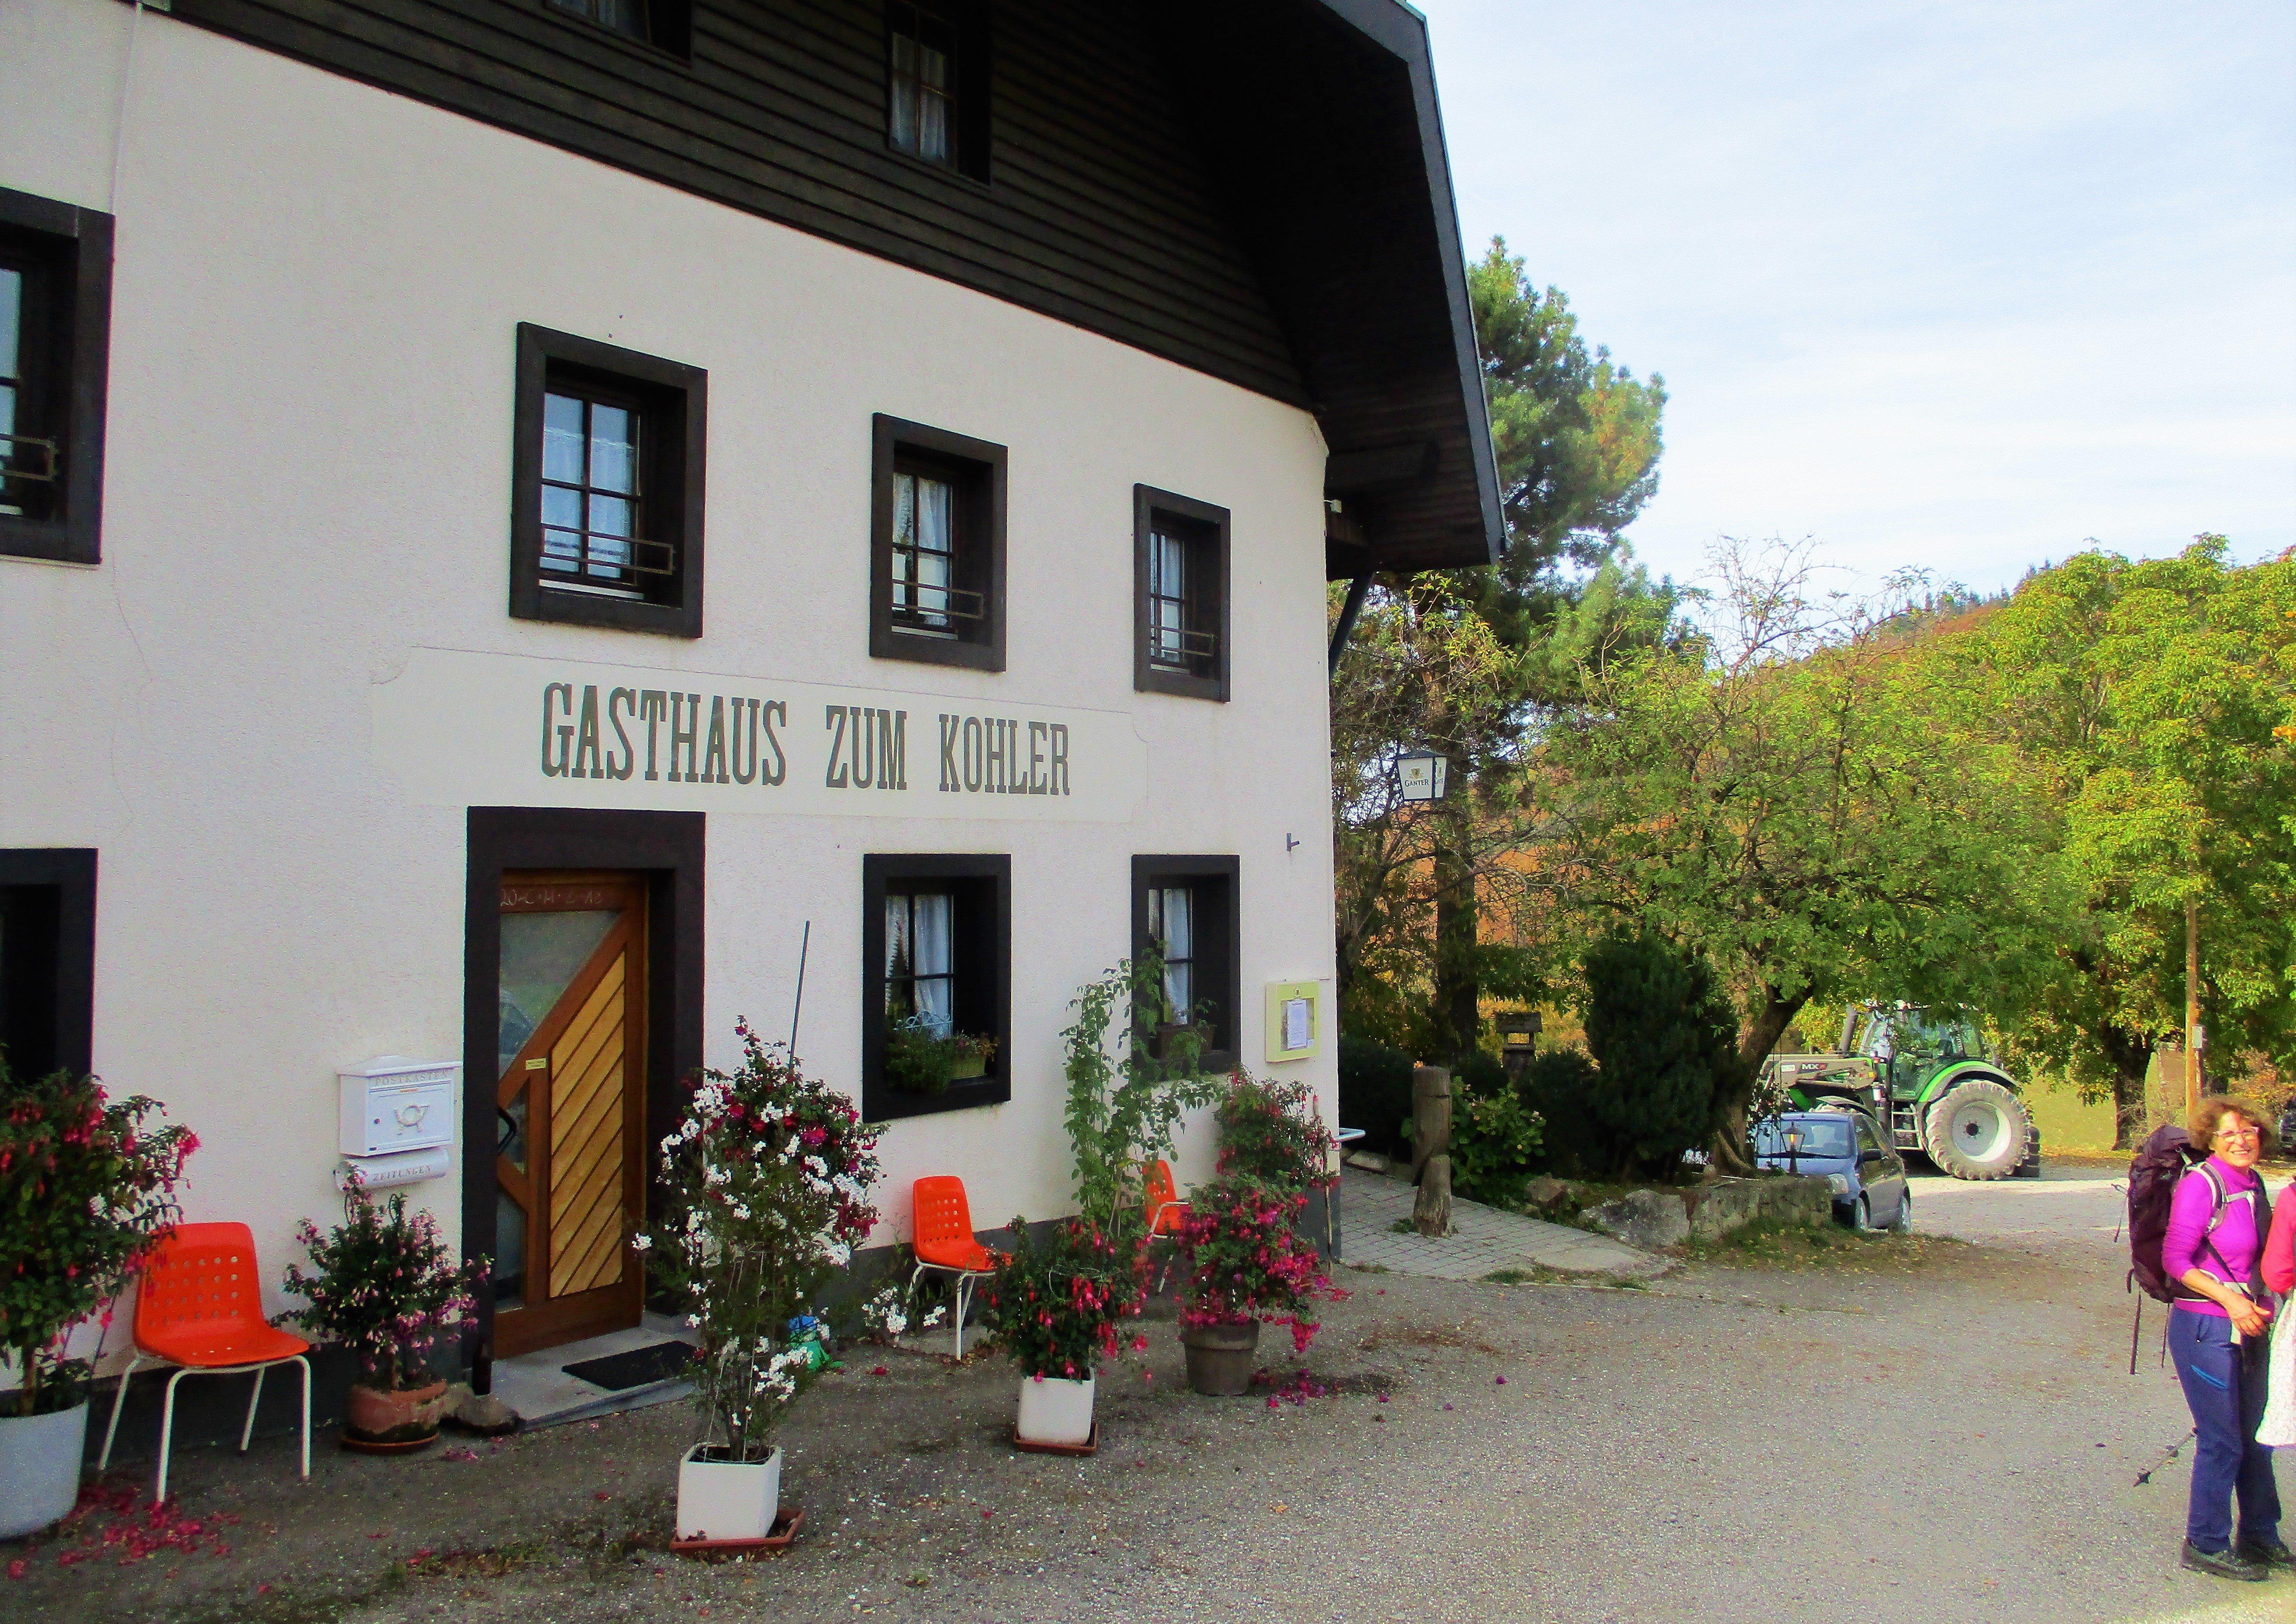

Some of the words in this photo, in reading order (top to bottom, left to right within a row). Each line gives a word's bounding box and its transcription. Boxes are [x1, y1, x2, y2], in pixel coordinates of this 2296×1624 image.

[541, 681, 787, 787] GASTHAUS
[826, 704, 908, 791] ZUM
[939, 713, 1071, 796] KOHLER
[1405, 779, 1429, 787] GANTER
